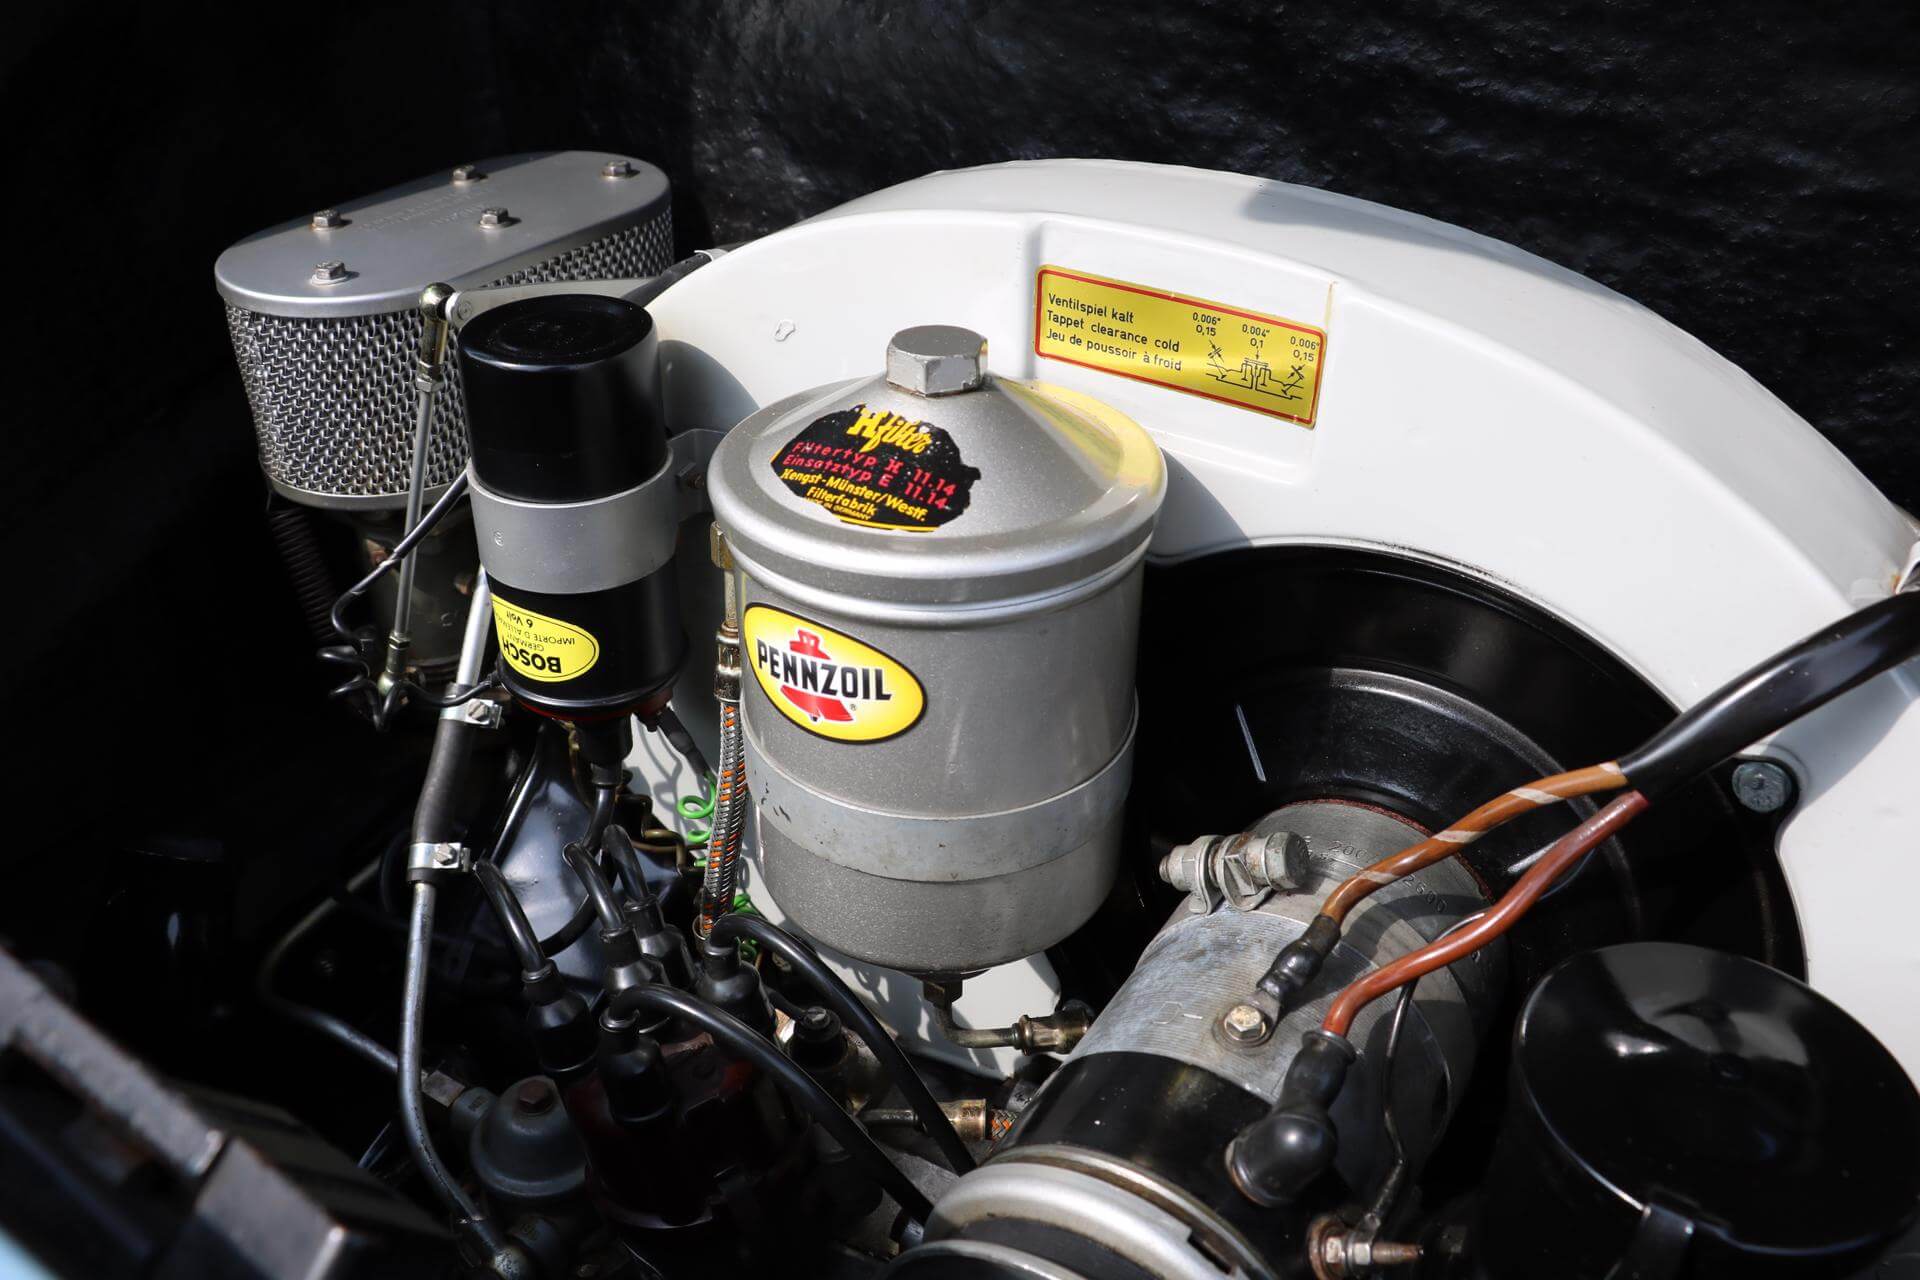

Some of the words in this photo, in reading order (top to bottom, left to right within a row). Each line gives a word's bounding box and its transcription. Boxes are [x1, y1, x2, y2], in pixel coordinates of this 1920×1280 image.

[1048, 293, 1108, 317] Ventilspiel
[1111, 308, 1134, 324] kalt
[1046, 328, 1066, 342] Jeu
[1069, 332, 1082, 346] de
[1086, 339, 1137, 360] poussoir
[1143, 350, 1151, 364] à
[1154, 354, 1182, 372] froid
[1047, 310, 1085, 331] Tappet
[1091, 321, 1148, 345] clearance
[1154, 336, 1180, 352] cold
[782, 454, 872, 482] Einsatztyp
[878, 473, 894, 487] E
[904, 483, 949, 510] 11.14
[792, 442, 878, 468] Filtertyp
[913, 468, 957, 496] 11.14
[806, 486, 879, 516] Filterfabrik
[506, 610, 524, 626] Volt
[526, 618, 533, 628] 6
[502, 635, 562, 674] BOSCH
[533, 633, 575, 646] IMPORTE
[756, 638, 893, 701] PENNZOIL
